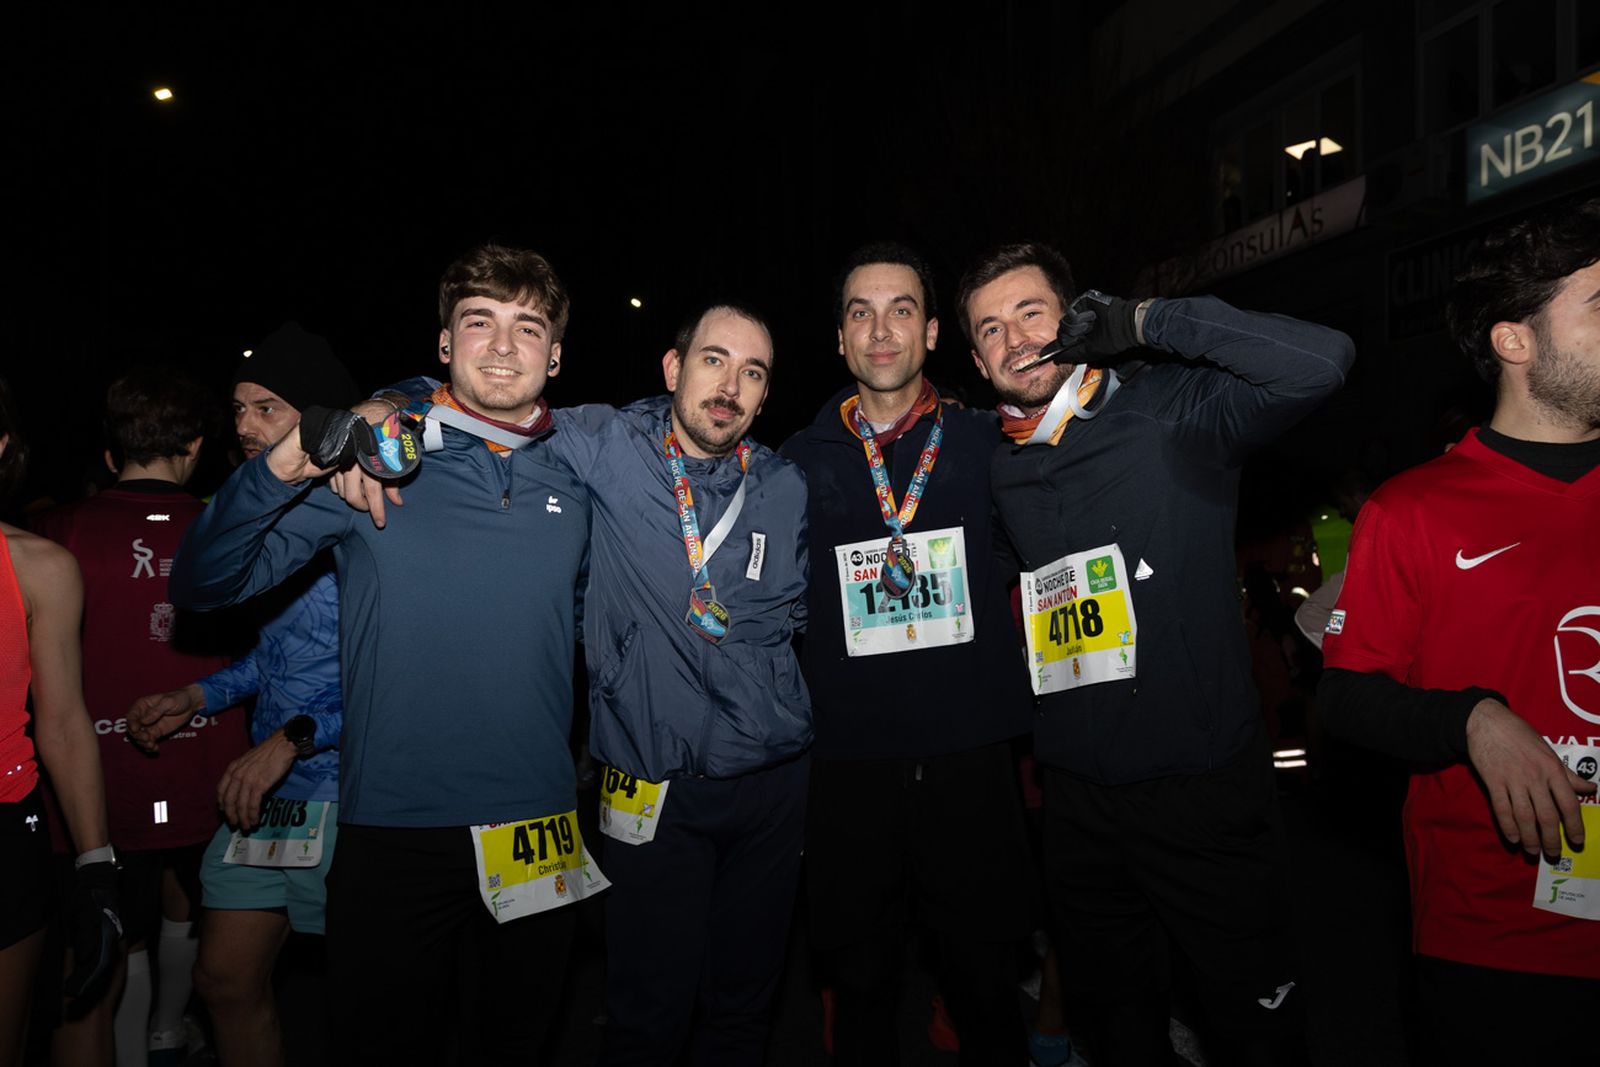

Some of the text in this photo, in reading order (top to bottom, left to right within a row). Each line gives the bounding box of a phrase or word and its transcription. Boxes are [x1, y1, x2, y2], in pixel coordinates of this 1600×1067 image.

[1481, 100, 1593, 187] NB21
[400, 433, 417, 460] 2026
[928, 428, 942, 454] NOCHE
[871, 456, 881, 468] DE
[922, 454, 932, 466] DE
[670, 459, 684, 488] NOCHE
[917, 467, 927, 484] SAN
[677, 490, 687, 501] DE
[680, 503, 691, 522] SAN
[752, 538, 761, 569] adidas
[854, 567, 878, 581] SAN
[706, 602, 728, 621] 2026
[1037, 595, 1053, 612] SAN
[1049, 599, 1103, 646] 4718
[1577, 762, 1596, 774] 43
[513, 816, 574, 866] 4719
